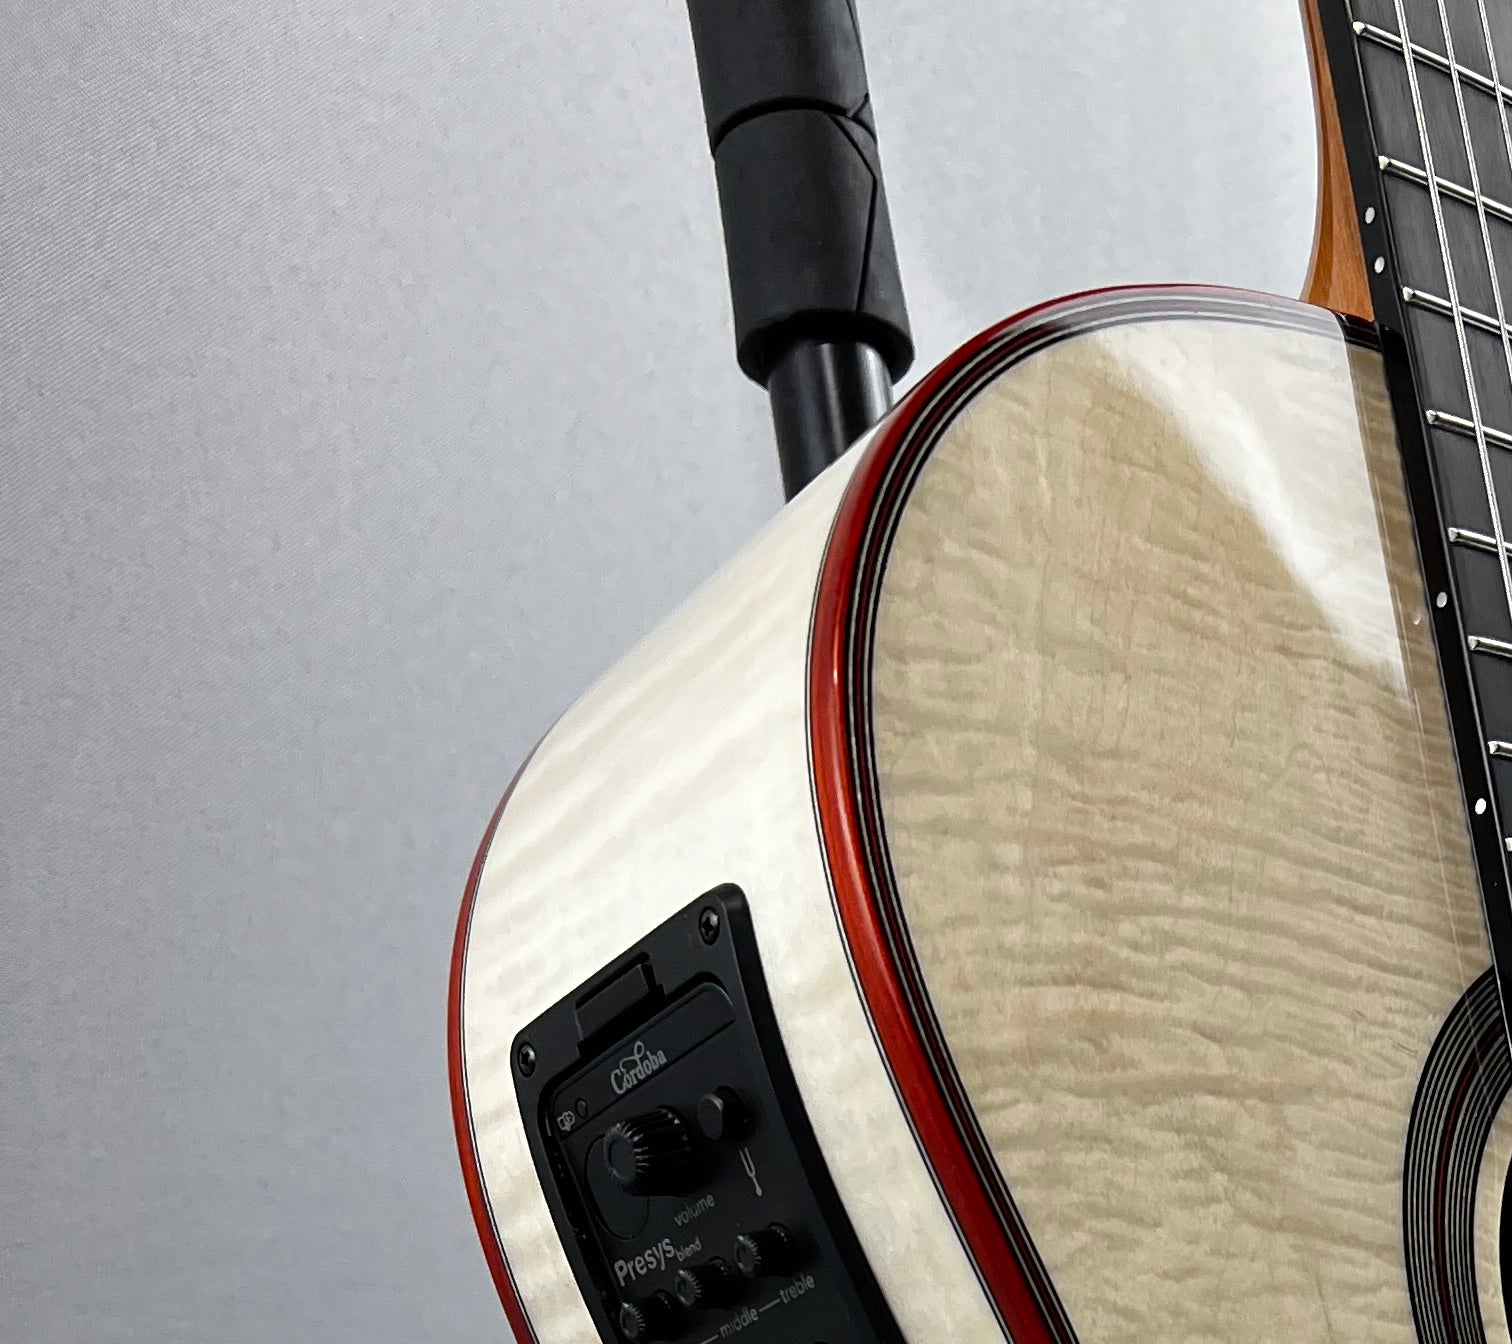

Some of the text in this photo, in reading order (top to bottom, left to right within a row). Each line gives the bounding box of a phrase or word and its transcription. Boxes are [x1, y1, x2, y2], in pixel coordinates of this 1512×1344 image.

[674, 1194, 716, 1227] volume
[613, 1238, 675, 1287] Presys
[674, 1236, 702, 1262] blend
[719, 1306, 760, 1339] middle
[779, 1273, 816, 1304] treble
